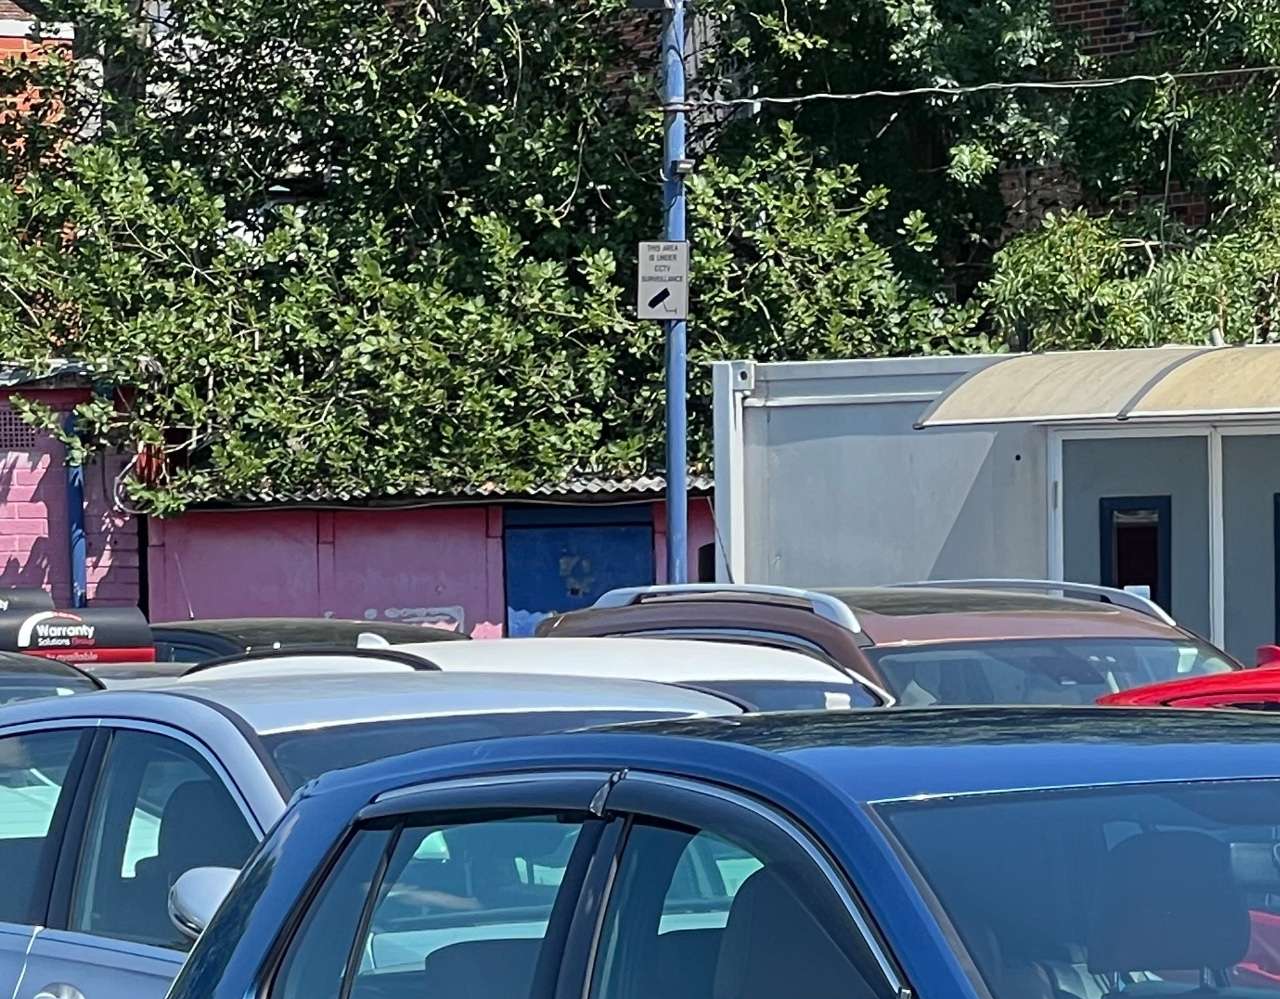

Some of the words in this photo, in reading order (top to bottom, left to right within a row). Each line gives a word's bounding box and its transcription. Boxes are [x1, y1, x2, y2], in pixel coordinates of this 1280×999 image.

[654, 264, 671, 272] CCTV
[36, 624, 94, 638] Warranty
[38, 638, 70, 646] Solutions
